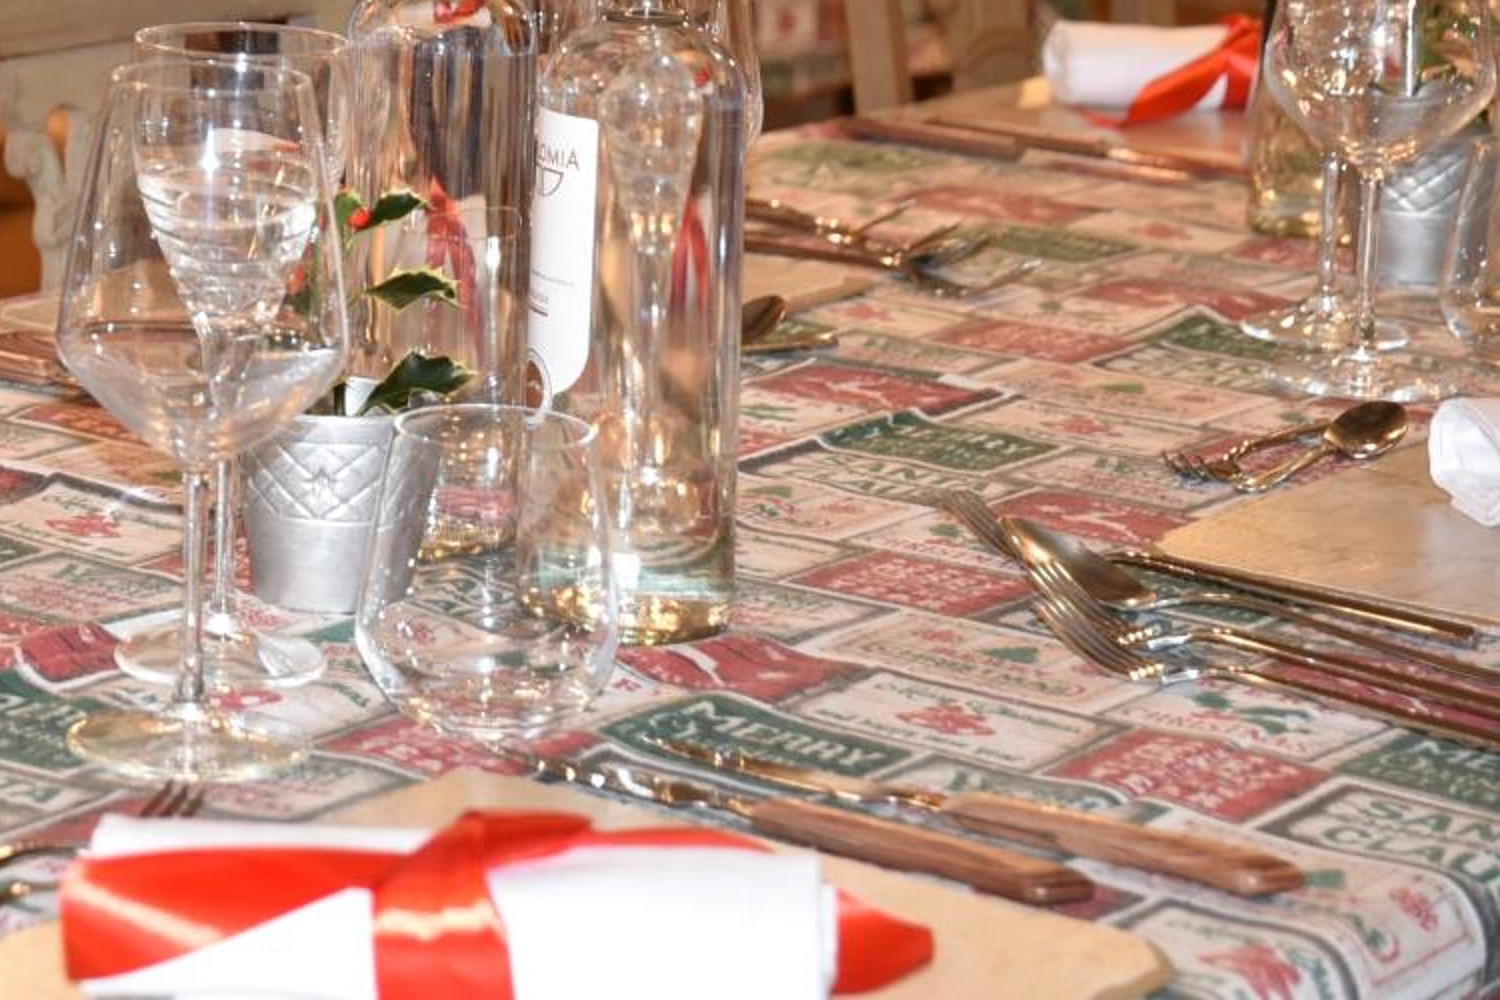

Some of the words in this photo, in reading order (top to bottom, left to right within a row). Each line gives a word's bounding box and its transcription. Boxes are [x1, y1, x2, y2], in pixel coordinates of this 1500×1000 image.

[536, 143, 580, 169] OMIA
[670, 700, 890, 766] MERRY
[1360, 801, 1500, 843] SAN
